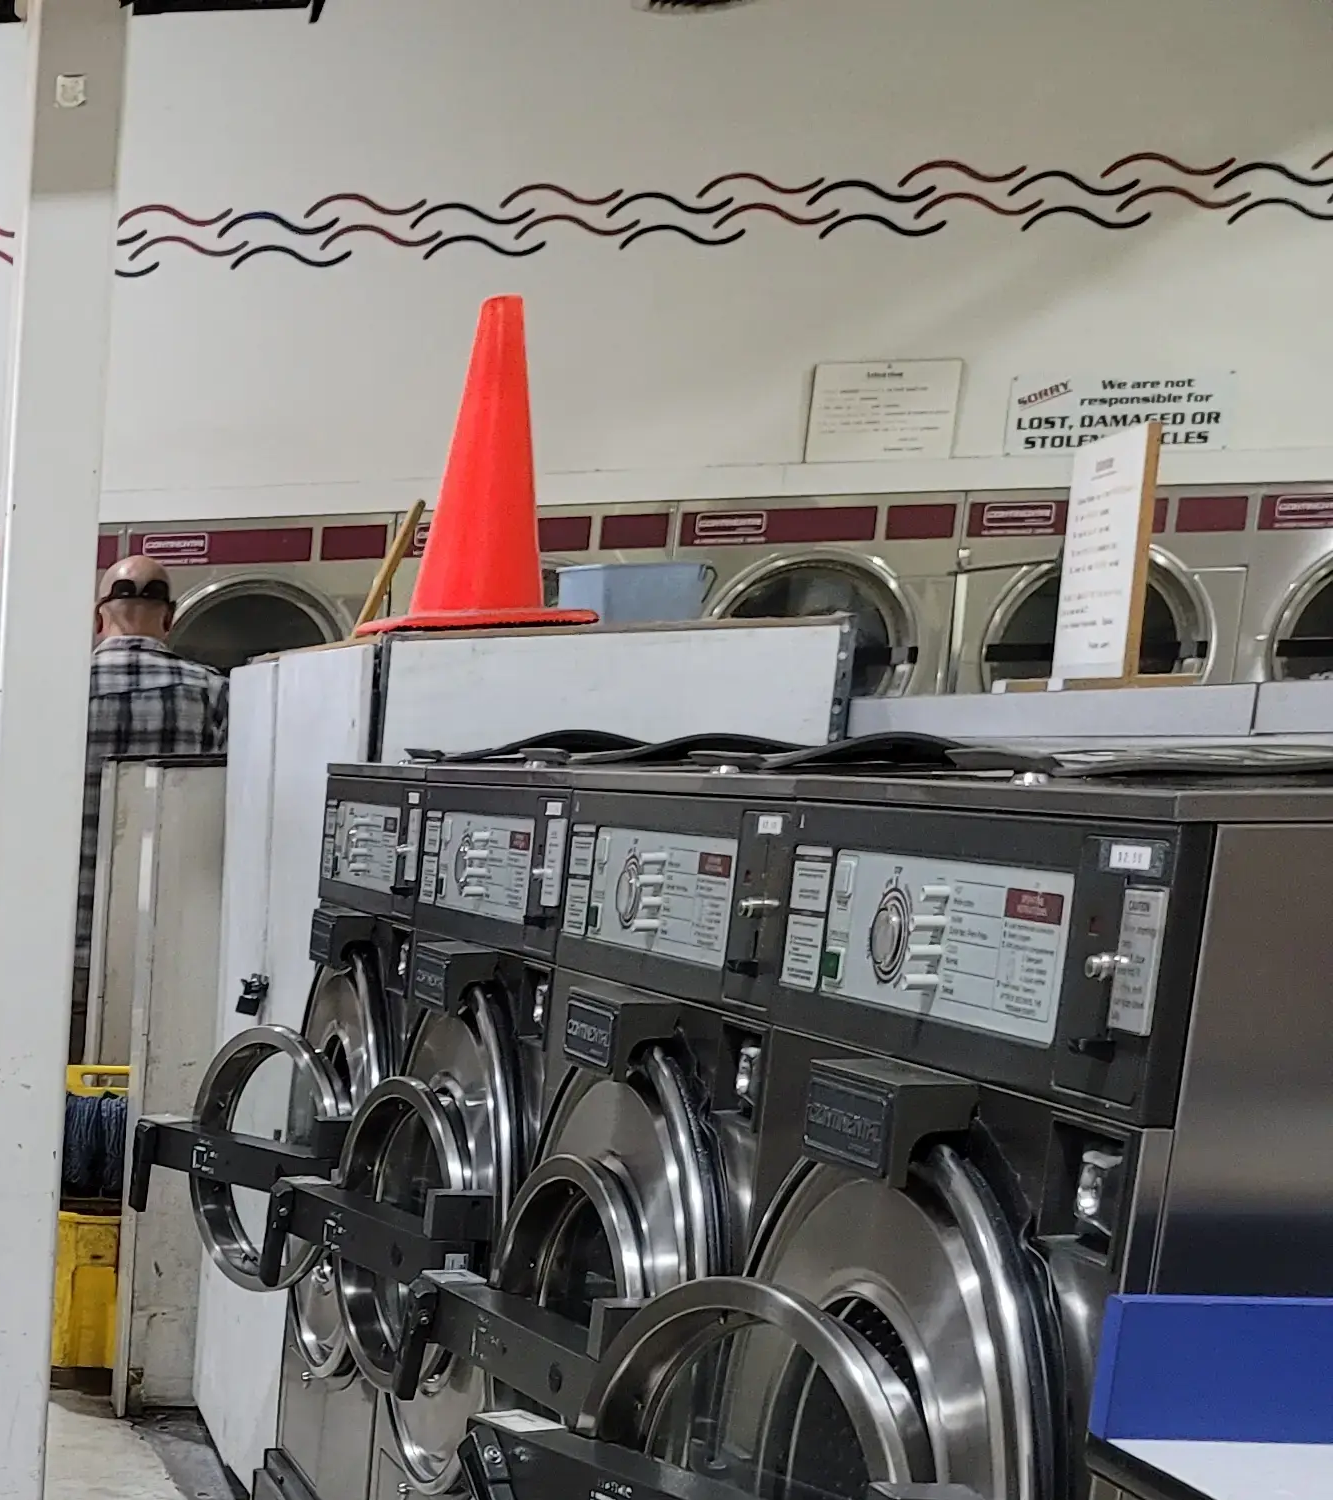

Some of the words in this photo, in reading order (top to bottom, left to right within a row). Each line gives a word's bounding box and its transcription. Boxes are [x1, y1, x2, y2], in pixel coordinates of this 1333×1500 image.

[1017, 379, 1072, 407] SORRY
[1101, 379, 1128, 390] We
[1130, 379, 1161, 389] are
[1164, 378, 1196, 389] not
[1079, 392, 1183, 408] responsible
[1185, 391, 1214, 404] for
[1016, 415, 1074, 431] LOST,
[1079, 411, 1186, 429] DAMAGED
[1190, 410, 1222, 425] OR
